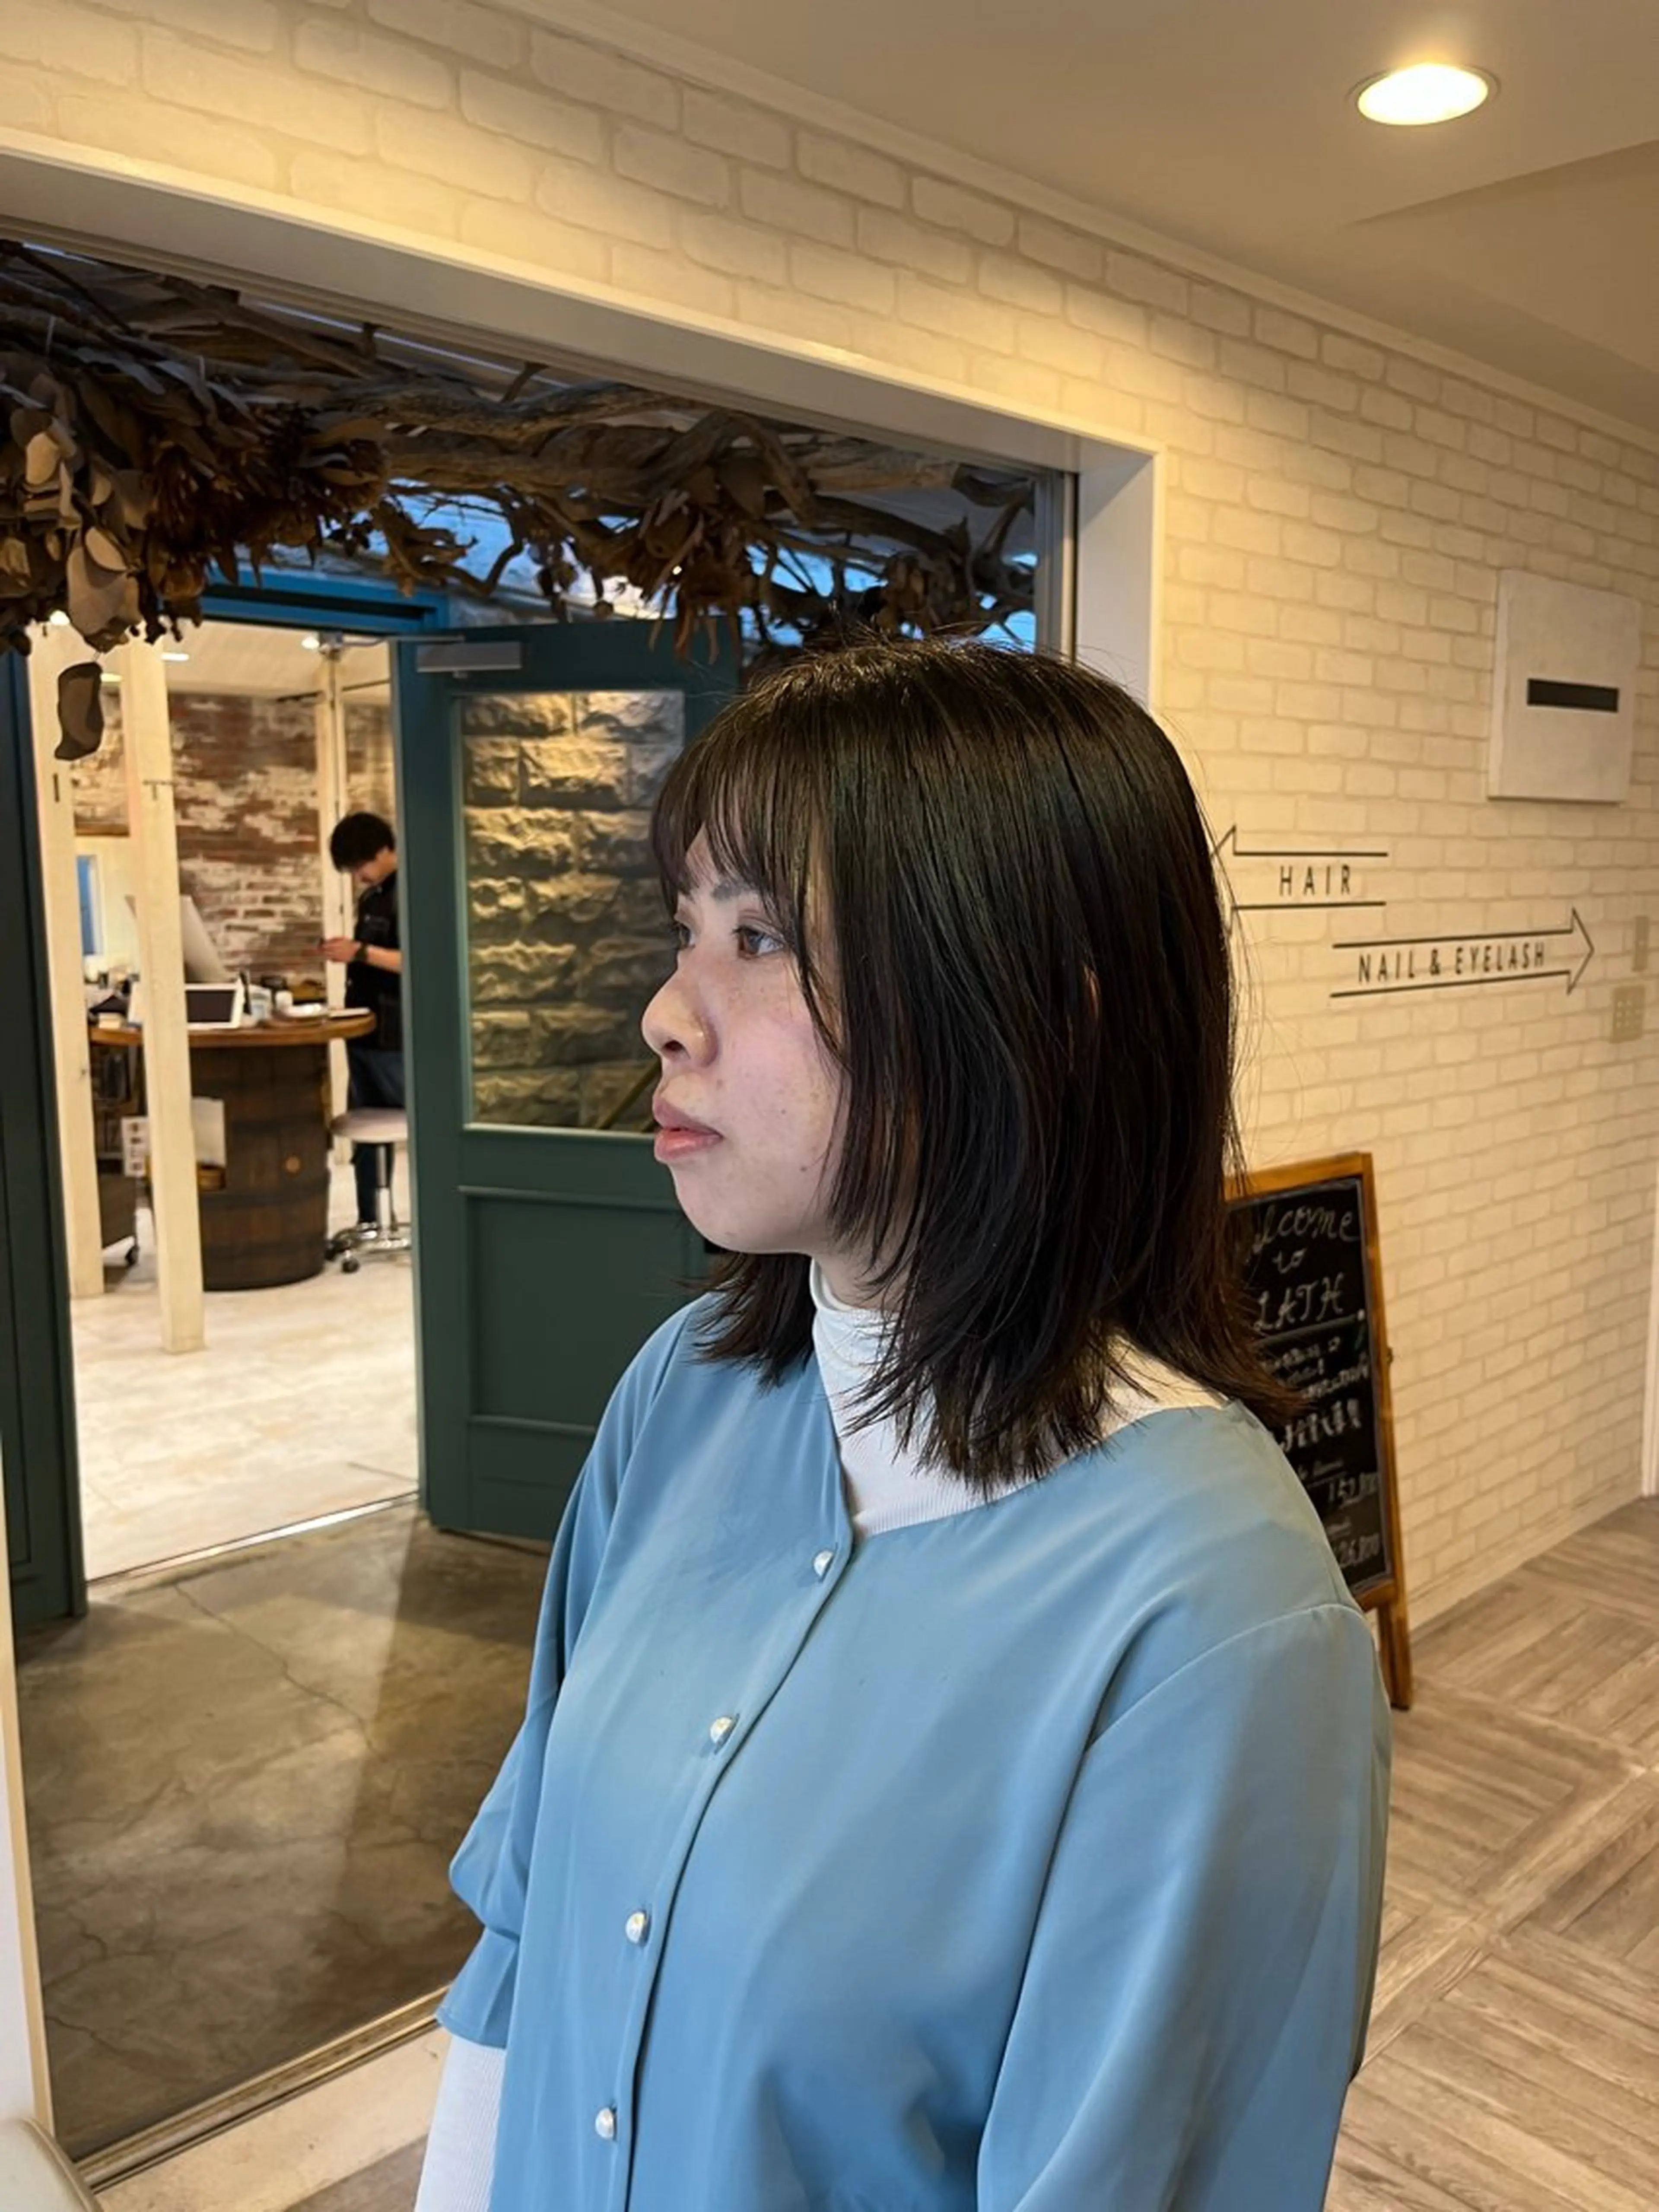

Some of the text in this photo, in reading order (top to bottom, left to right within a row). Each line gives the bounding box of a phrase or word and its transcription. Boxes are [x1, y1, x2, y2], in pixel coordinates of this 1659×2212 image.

[1279, 864, 1351, 896] HAIR
[1358, 942, 1545, 983] NAIL & EYELASH
[1272, 1248, 1308, 1275] to
